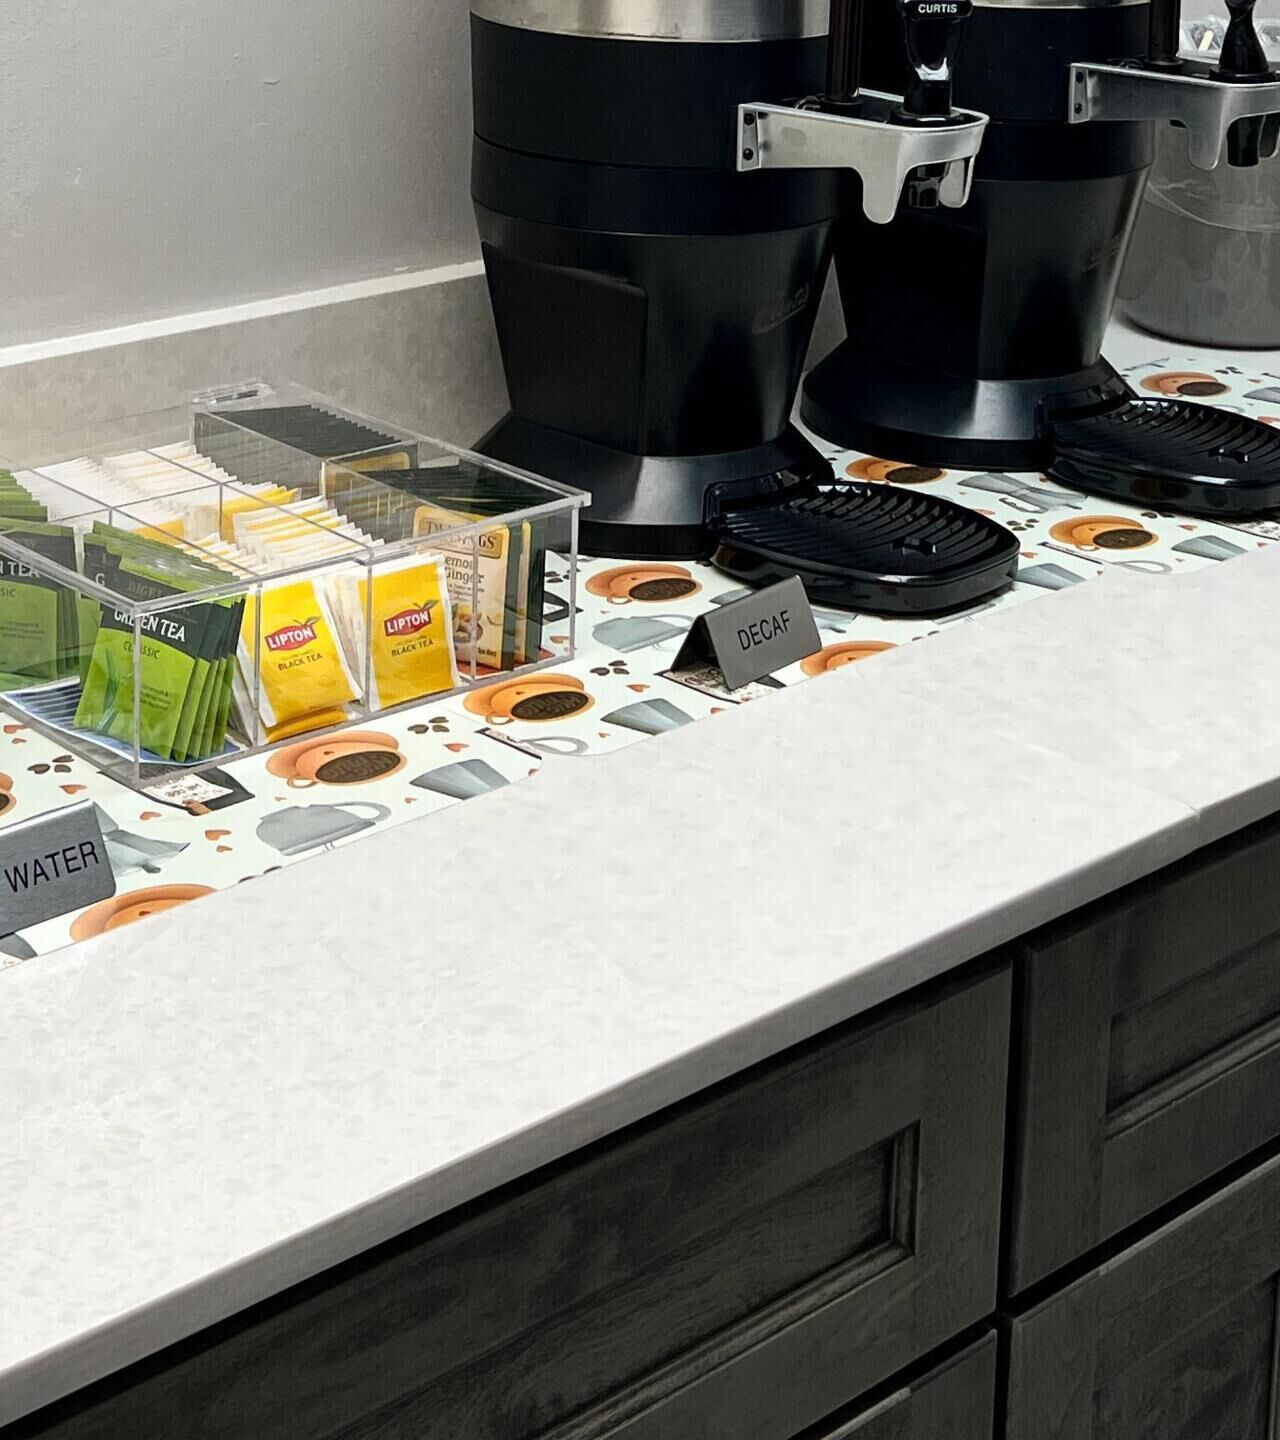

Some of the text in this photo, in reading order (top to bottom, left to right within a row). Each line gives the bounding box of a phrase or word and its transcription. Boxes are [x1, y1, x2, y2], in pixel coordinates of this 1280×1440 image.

[918, 3, 958, 14] CURTIS
[160, 618, 186, 643] TEA
[386, 610, 430, 633] LIPTON
[737, 609, 791, 651] DECAF
[266, 626, 315, 650] LIPTON
[391, 643, 417, 657] BLACK
[418, 638, 434, 649] TEA
[123, 640, 161, 660] CLSSIC
[277, 658, 306, 672] BLACK
[306, 653, 323, 664] TEA
[4, 840, 100, 893] WATER
